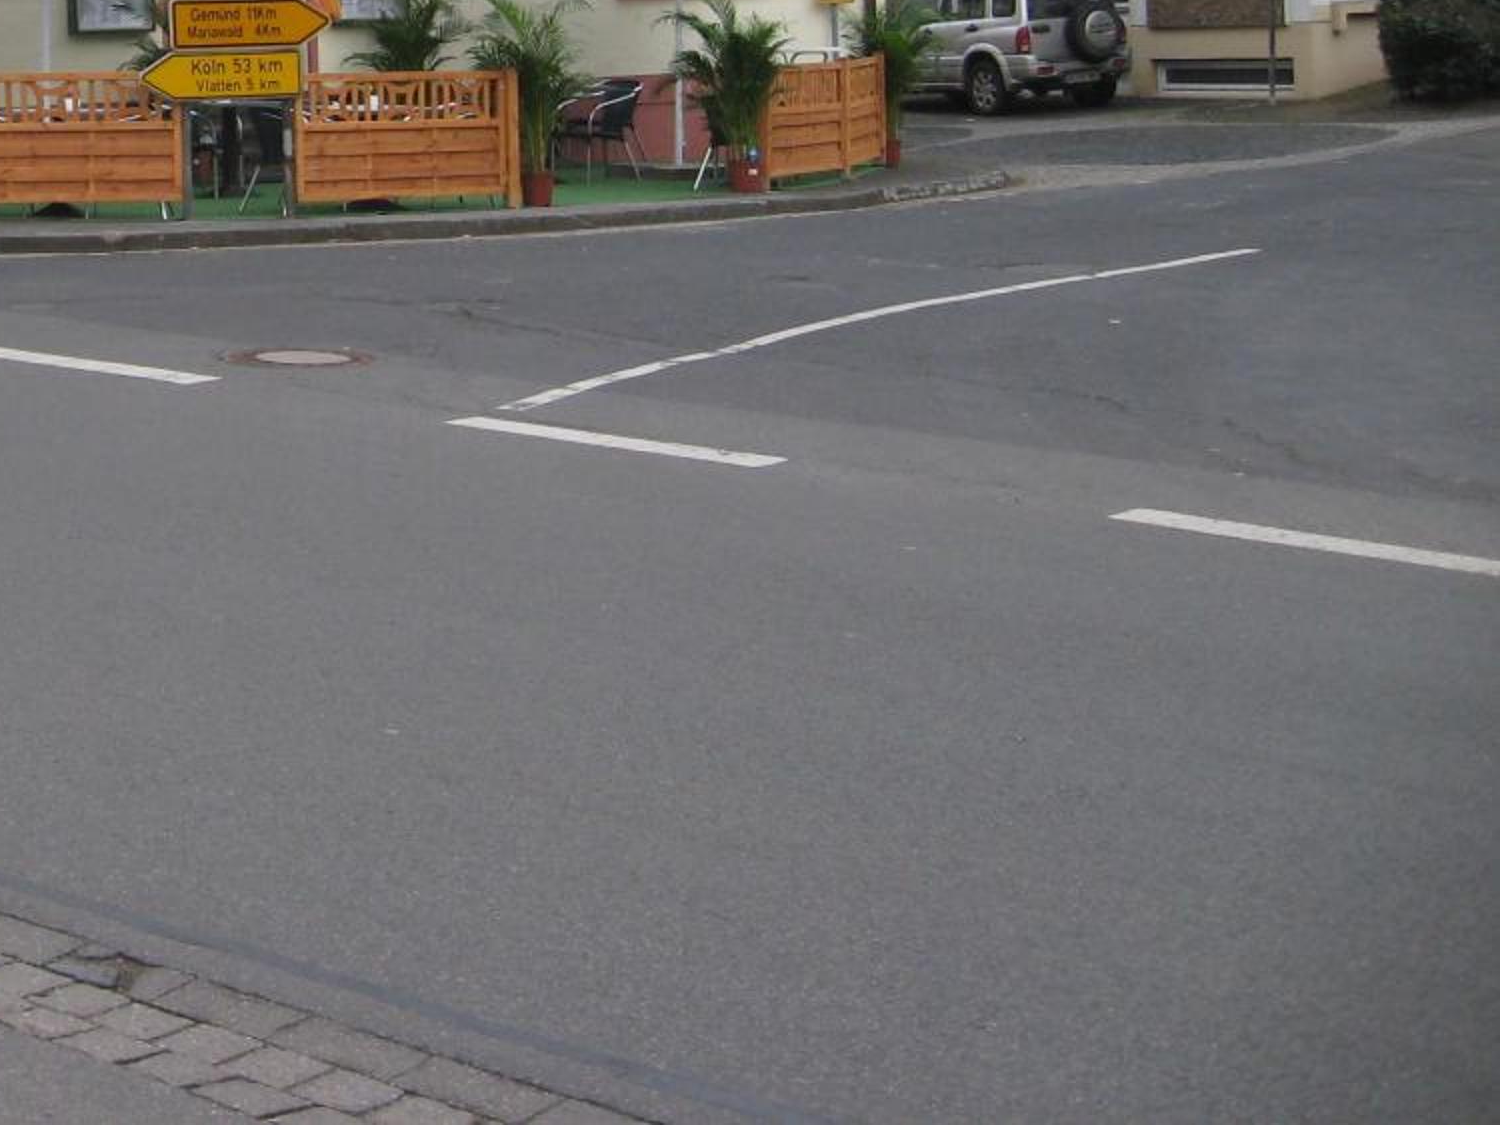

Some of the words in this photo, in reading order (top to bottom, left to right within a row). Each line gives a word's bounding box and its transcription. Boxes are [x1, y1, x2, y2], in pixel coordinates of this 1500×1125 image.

[190, 6, 241, 22] Gemünd
[187, 25, 244, 39] Mariawald
[191, 57, 226, 76] Köln
[232, 58, 251, 74] 53
[258, 58, 283, 73] km
[195, 77, 242, 93] Vlatten
[259, 77, 280, 91] km
